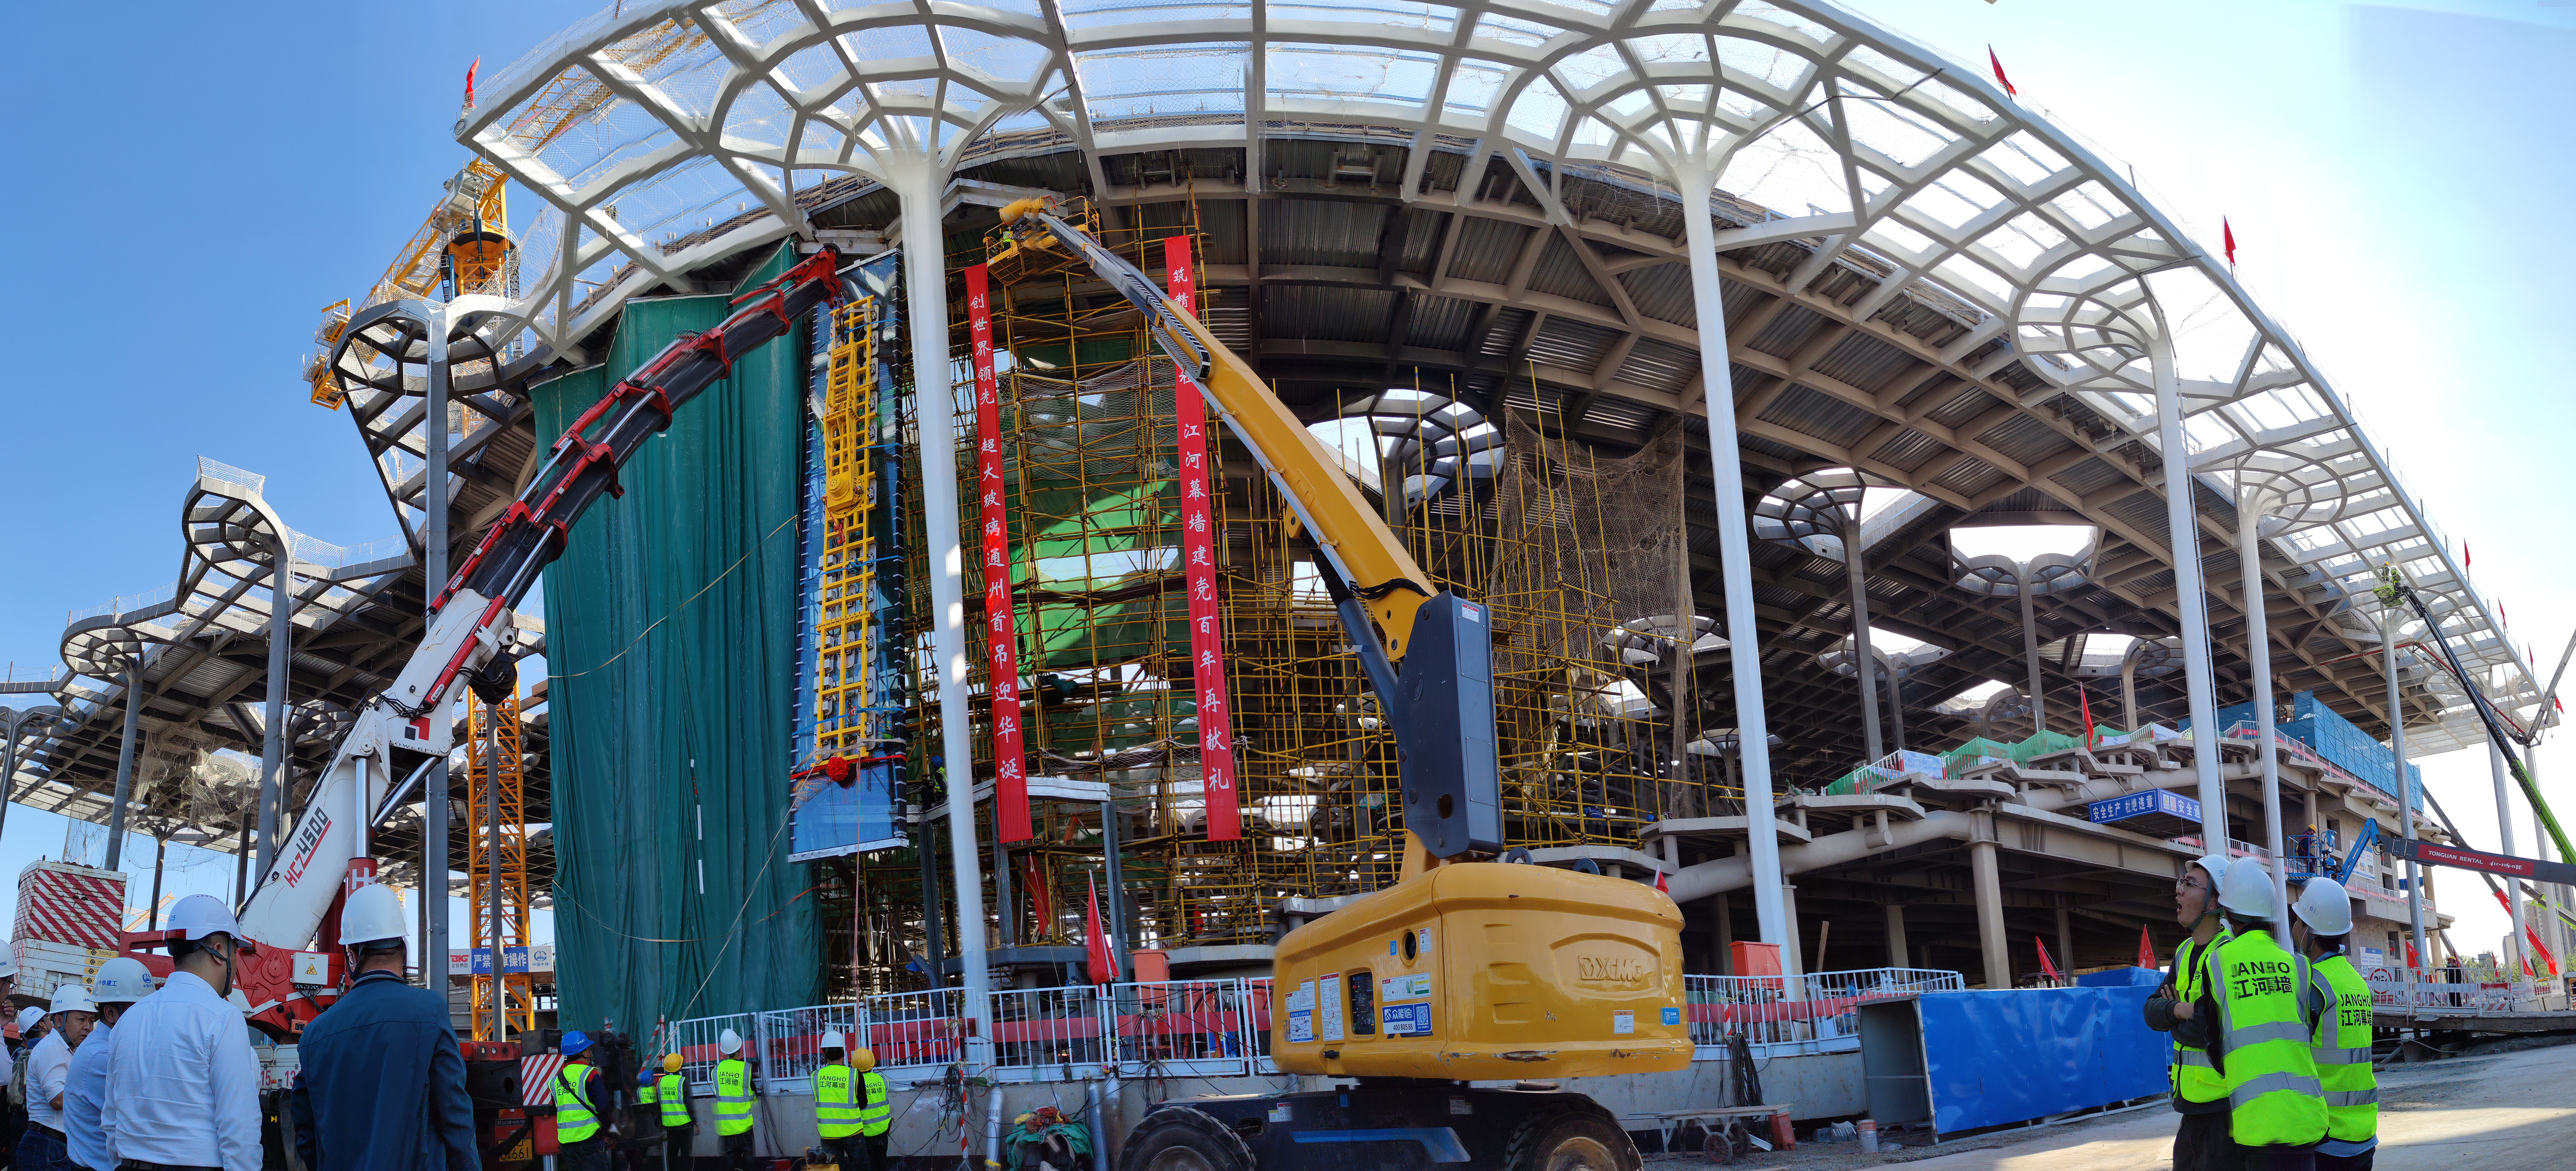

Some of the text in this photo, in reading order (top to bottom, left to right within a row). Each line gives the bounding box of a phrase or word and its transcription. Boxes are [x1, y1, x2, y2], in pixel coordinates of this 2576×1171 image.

[970, 293, 1021, 780] 创世界领先 超大玻璃通州首吊迎华诞
[1183, 422, 1230, 792] 江河幕墙建党百年再献礼
[2093, 794, 2153, 821] 安全生产 杜绝违章
[284, 806, 332, 889] HCZ4500
[2428, 850, 2457, 860] TONGUAN
[2459, 856, 2483, 865] RENTAL
[2340, 994, 2371, 1007] JANGHO
[2341, 1009, 2372, 1026] 江河幕墙
[261, 1070, 271, 1086] 15
